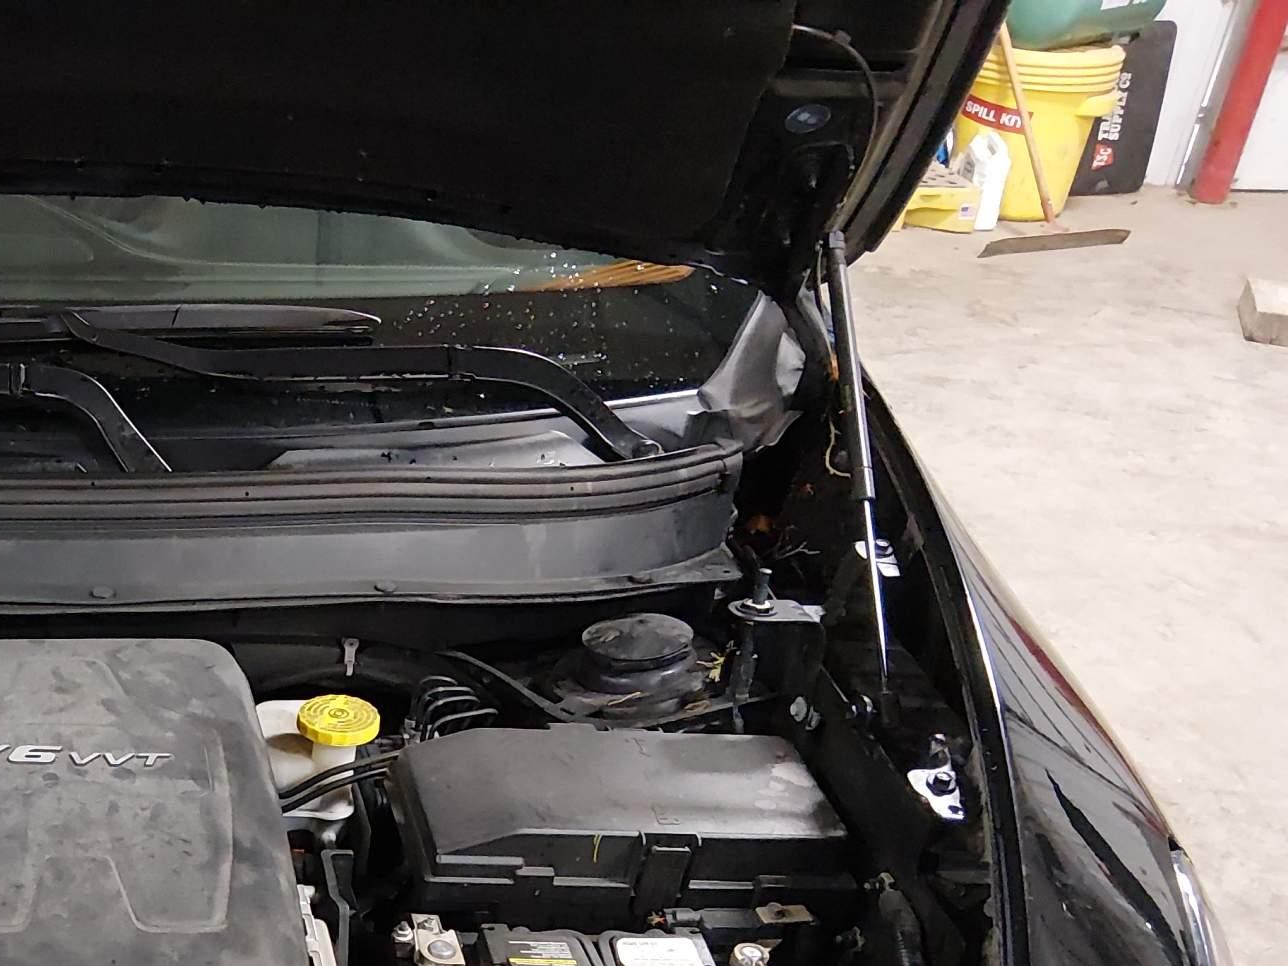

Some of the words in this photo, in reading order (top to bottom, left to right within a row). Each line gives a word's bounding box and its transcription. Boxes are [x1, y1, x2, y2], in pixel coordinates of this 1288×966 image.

[965, 100, 997, 122] SPILL
[1092, 148, 1113, 170] TSC
[69, 752, 174, 767] VVT
